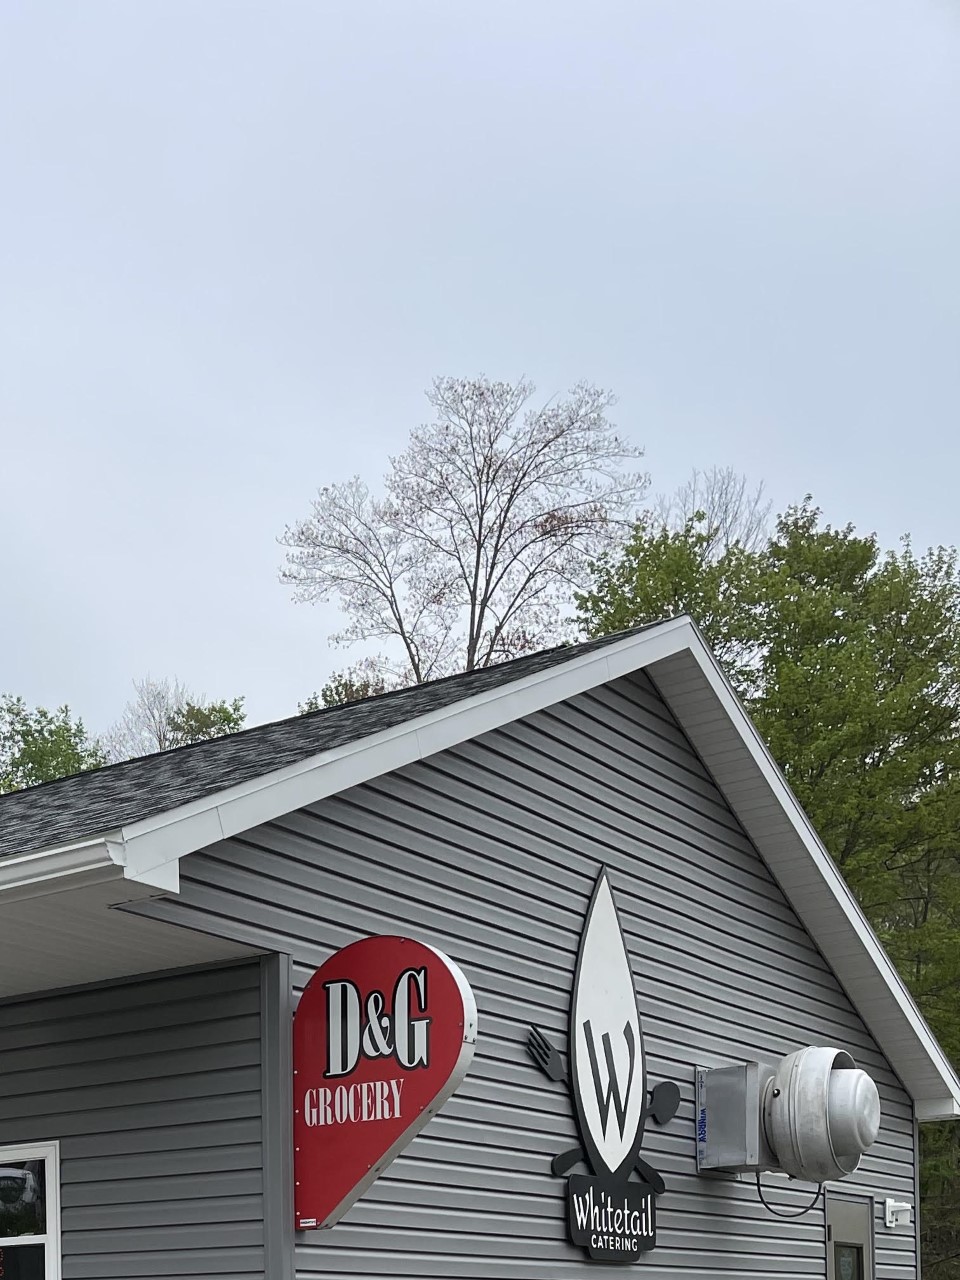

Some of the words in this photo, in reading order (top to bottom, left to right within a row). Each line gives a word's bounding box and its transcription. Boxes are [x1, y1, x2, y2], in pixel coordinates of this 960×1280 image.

[323, 965, 431, 1079] D&G
[303, 1078, 405, 1128] GROCERY
[582, 1019, 635, 1144] W
[573, 1185, 654, 1237] Whitetail
[591, 1234, 638, 1252] CATERING
